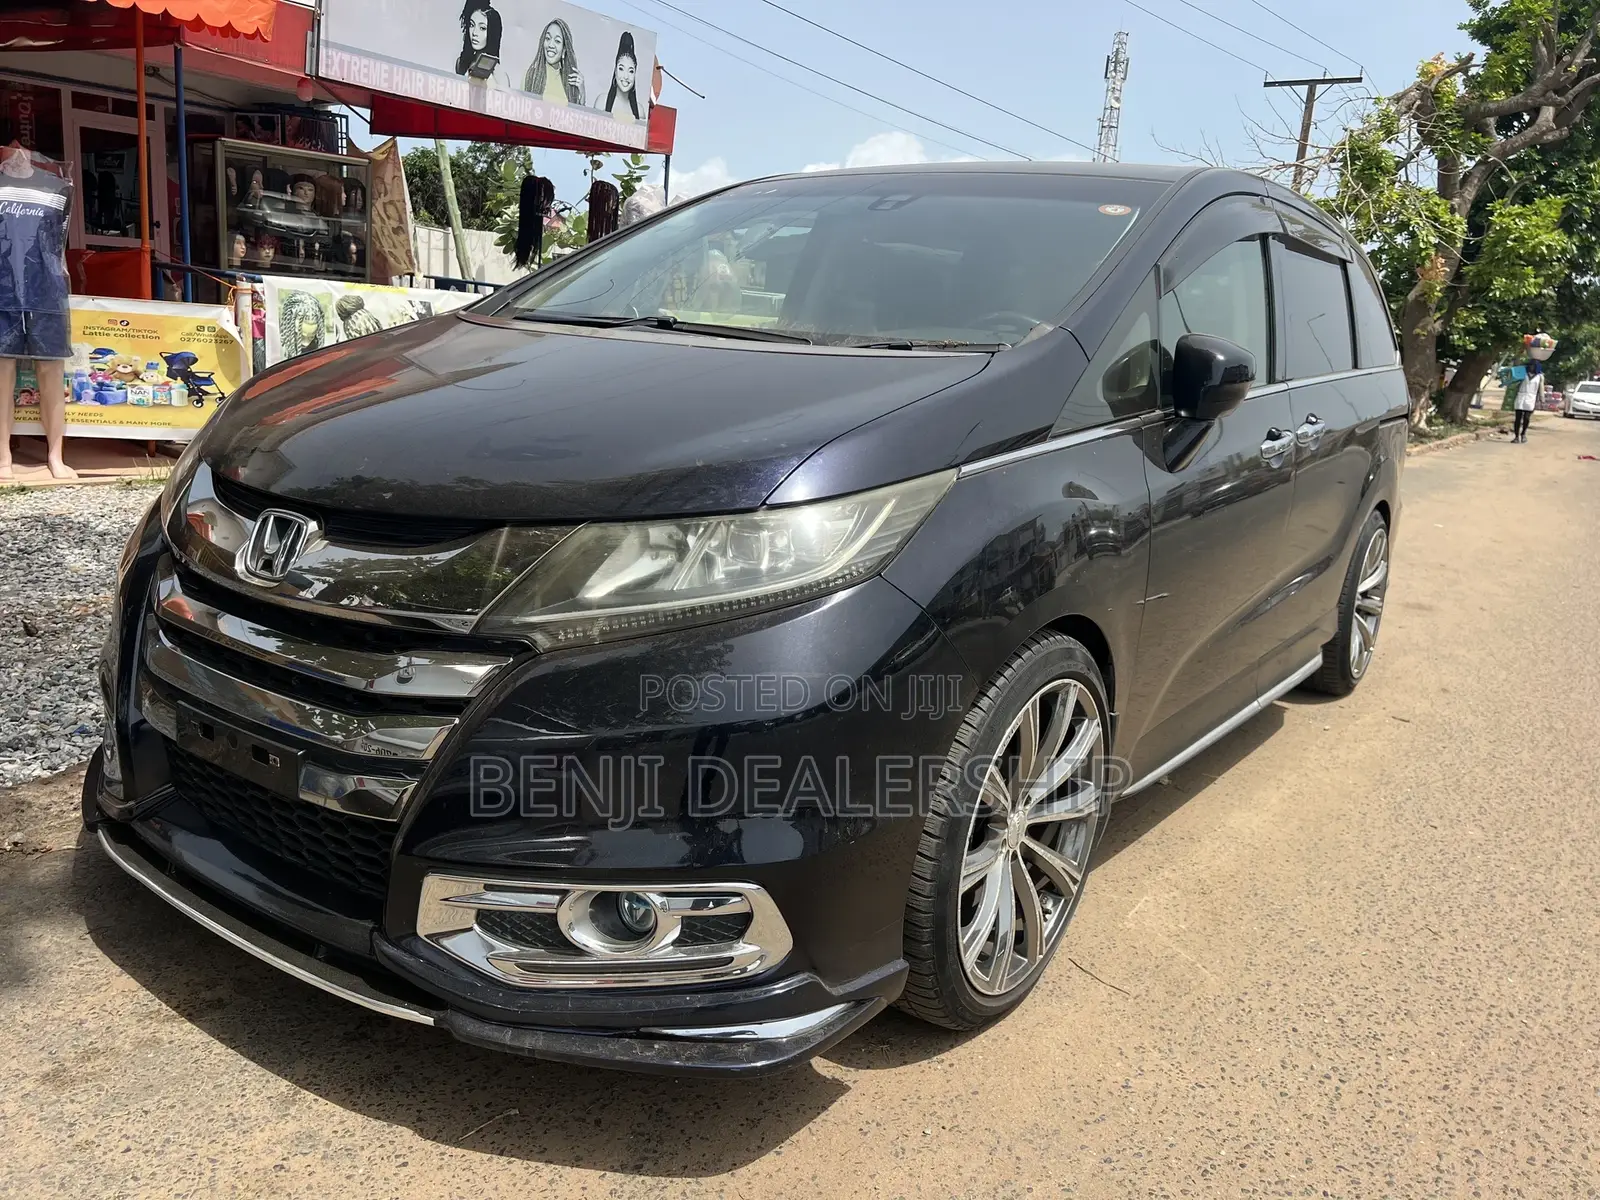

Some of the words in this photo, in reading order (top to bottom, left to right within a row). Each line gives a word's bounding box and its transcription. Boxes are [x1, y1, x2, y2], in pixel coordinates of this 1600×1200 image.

[320, 47, 389, 87] EXTREME
[392, 67, 425, 95] HAIR
[428, 76, 477, 110] BEAUTY
[0, 201, 45, 218] California
[83, 325, 159, 334] INSTAGRAM/TIKTOK
